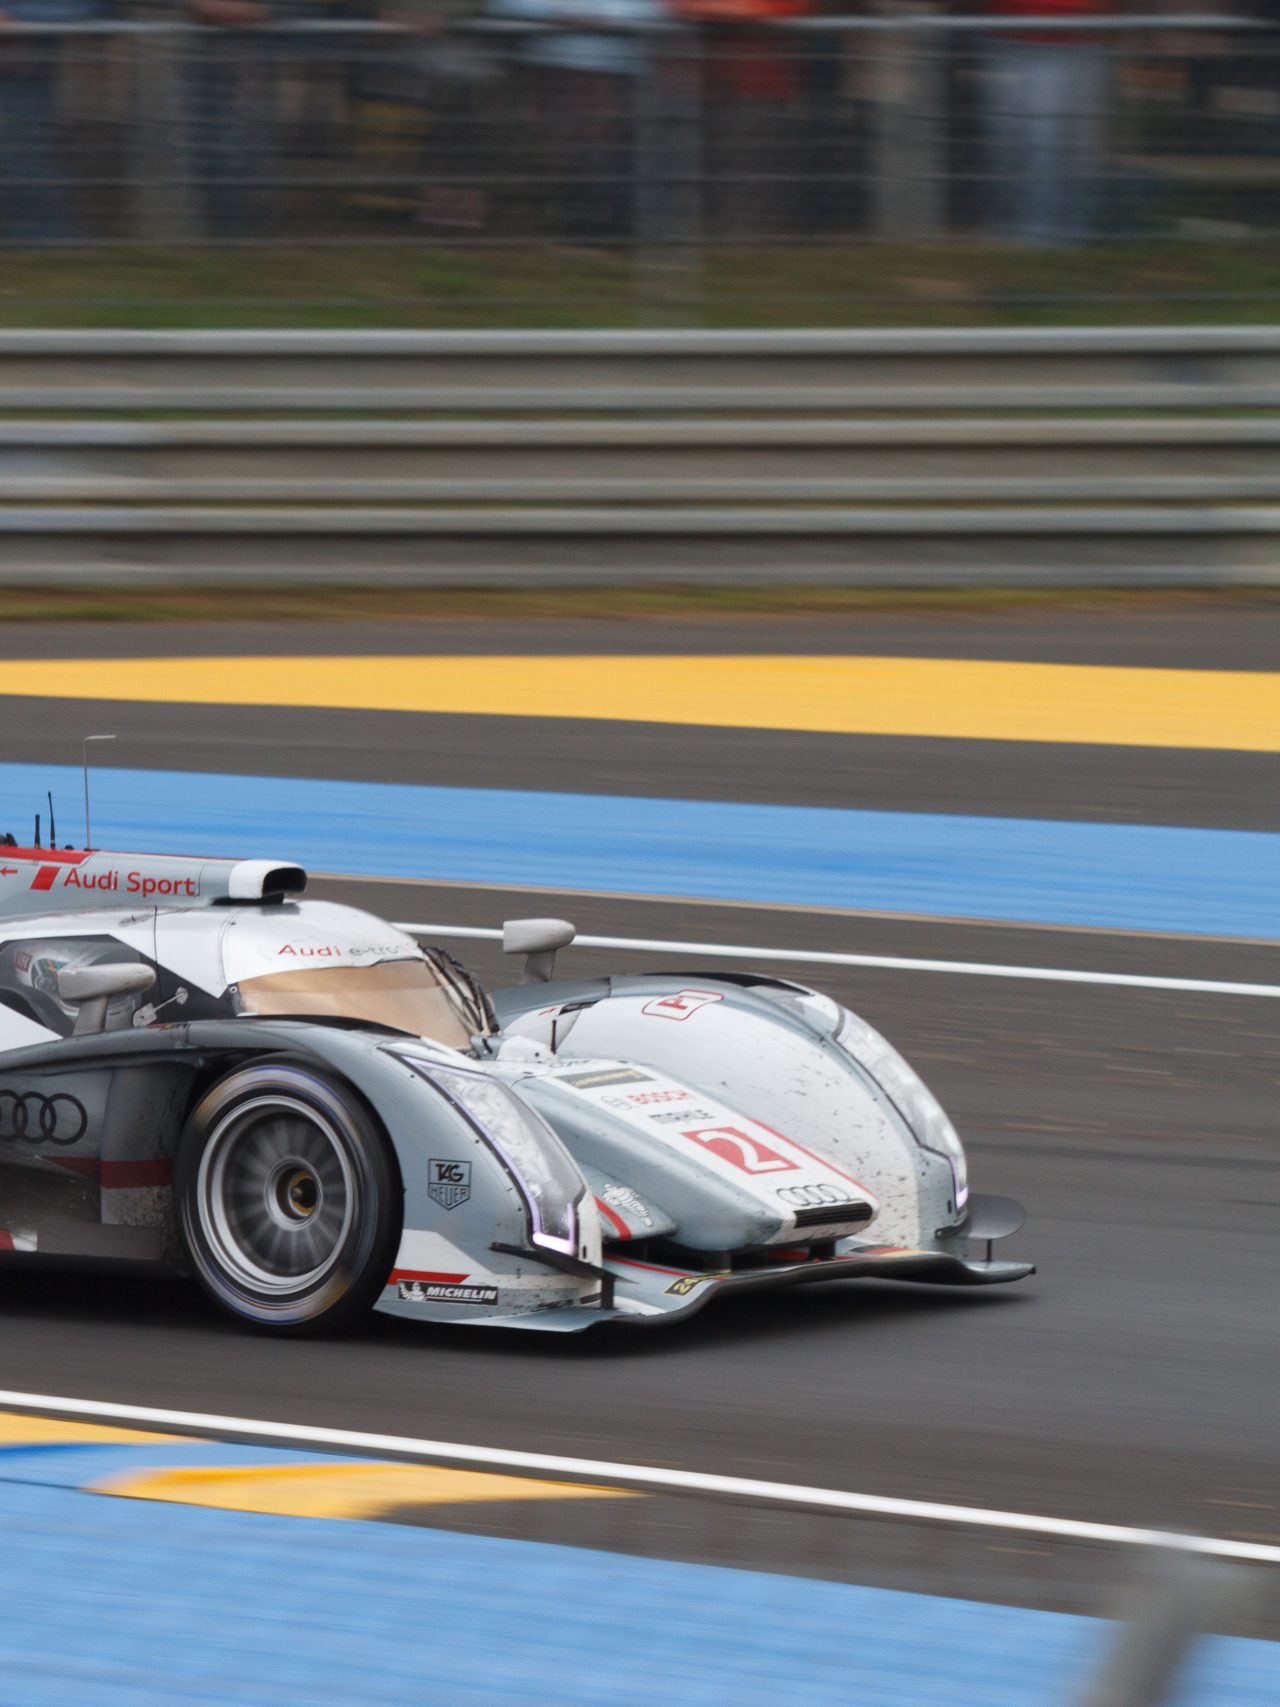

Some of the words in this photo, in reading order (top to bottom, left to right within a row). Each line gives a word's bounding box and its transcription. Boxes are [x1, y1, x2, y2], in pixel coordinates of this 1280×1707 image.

[63, 868, 118, 891] Audi
[126, 872, 196, 898] Sport
[278, 944, 342, 957] Audi
[696, 1130, 791, 1171] 2
[435, 1163, 464, 1183] TAG
[430, 1185, 468, 1207] HEUER
[426, 1286, 497, 1300] MICHELIN
